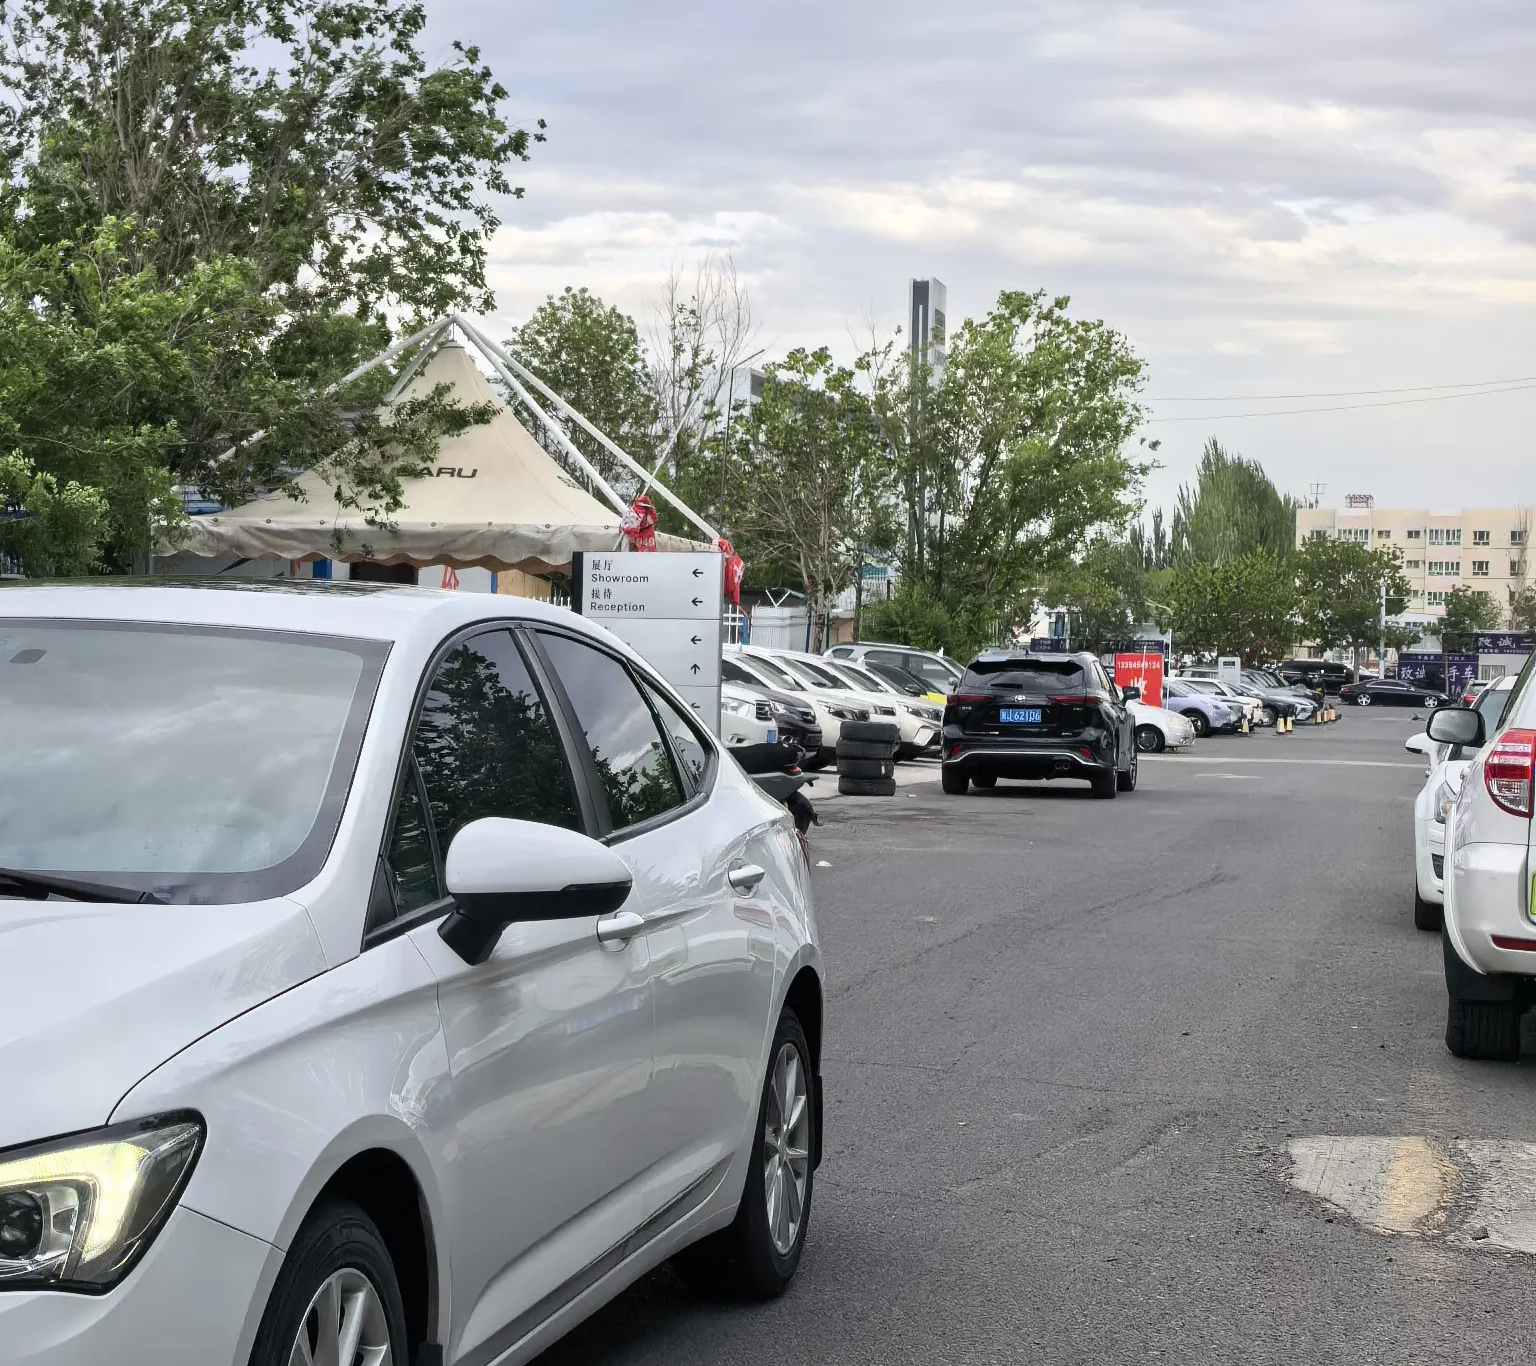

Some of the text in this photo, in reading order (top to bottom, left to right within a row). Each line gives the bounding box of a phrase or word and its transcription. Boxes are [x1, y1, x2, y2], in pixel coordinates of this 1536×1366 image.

[591, 559, 613, 571] 展厅
[591, 573, 649, 583] Showroom
[591, 587, 612, 600] 接待
[590, 601, 645, 613] Reception
